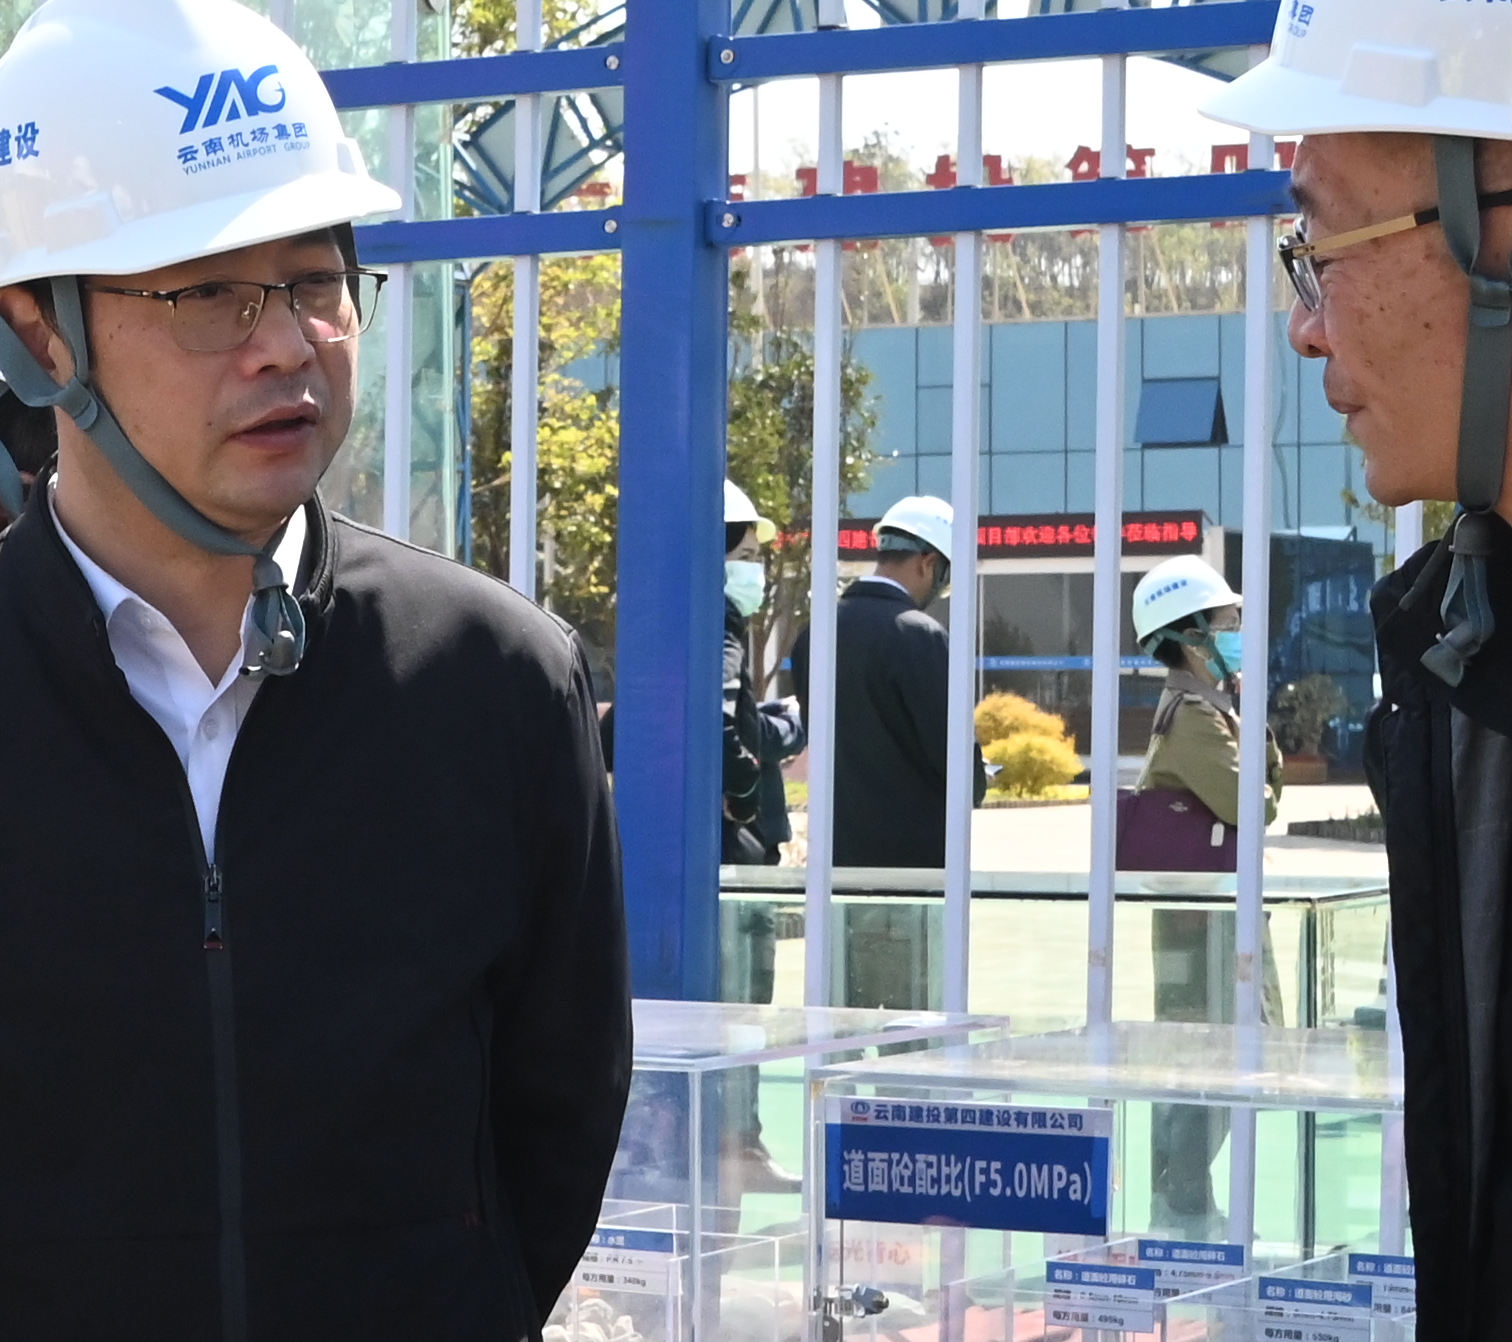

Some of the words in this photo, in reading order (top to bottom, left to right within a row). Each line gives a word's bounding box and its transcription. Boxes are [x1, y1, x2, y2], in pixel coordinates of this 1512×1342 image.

[176, 122, 309, 165] 云南机场集团
[182, 155, 232, 176] YUNNAN
[236, 144, 277, 161] AIRPORT
[283, 141, 311, 153] GROUP
[874, 1104, 1084, 1132] 云南建投第四建设有限公司
[842, 1148, 1093, 1206] 道面砼配比(F5.0MPa)
